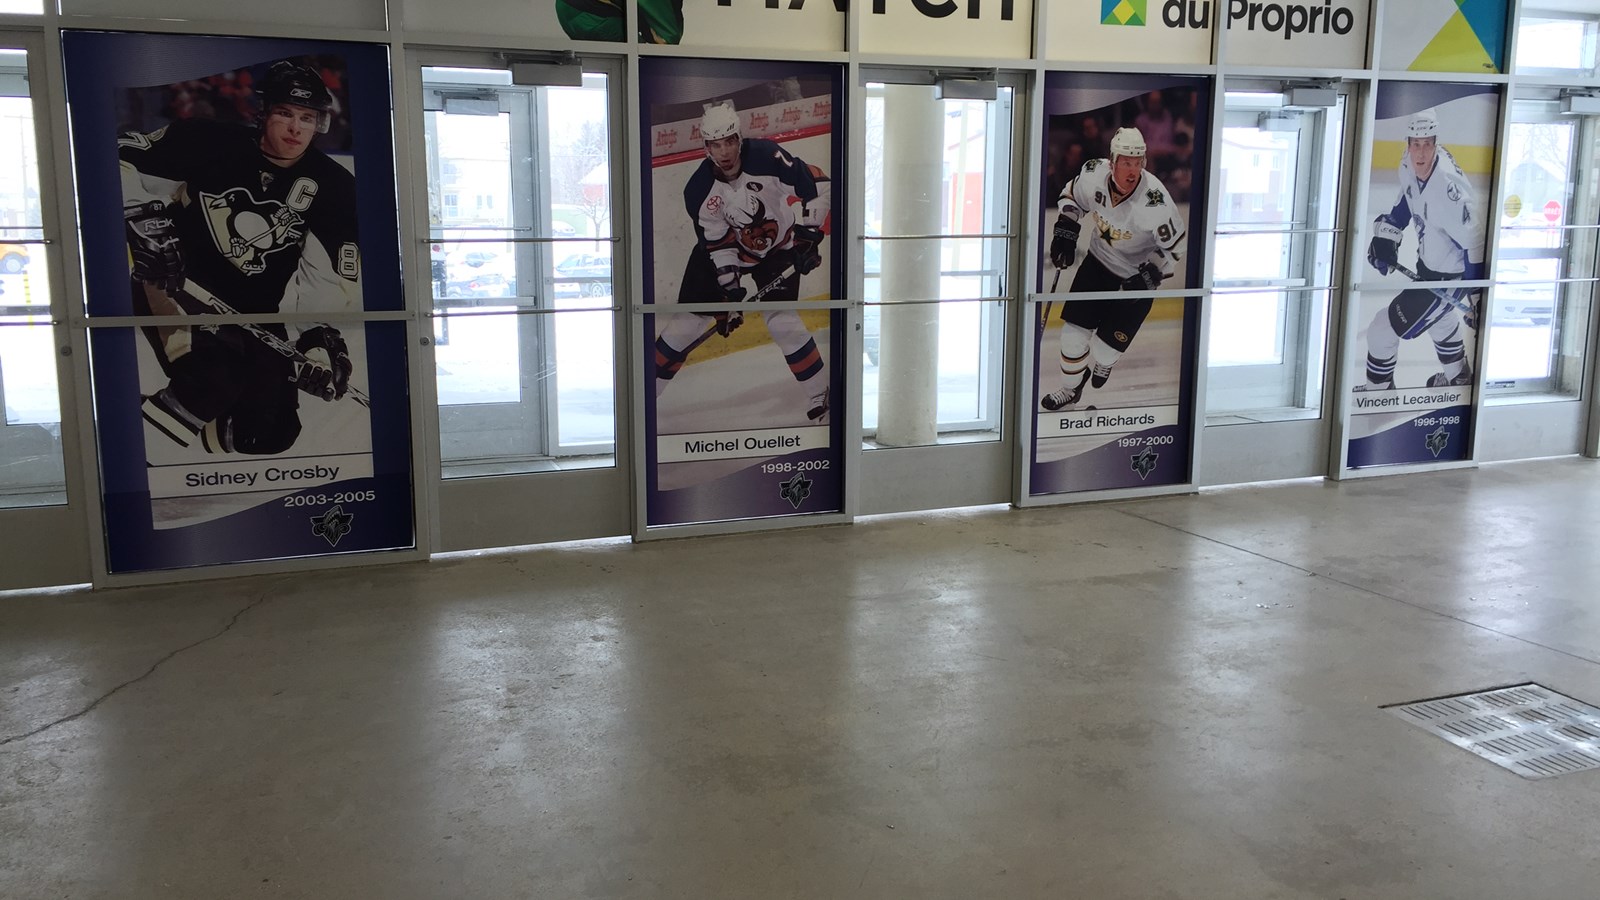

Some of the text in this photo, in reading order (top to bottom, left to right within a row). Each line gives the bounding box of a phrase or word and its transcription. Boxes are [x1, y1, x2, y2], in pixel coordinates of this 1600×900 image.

[1226, 0, 1354, 40] Proprio
[285, 177, 319, 212] C
[1094, 190, 1107, 208] 91
[1156, 217, 1178, 243] 91
[1356, 392, 1461, 408] Vincent Lecavalier
[1059, 413, 1155, 430] Brad Richards
[1413, 416, 1460, 428] 1996-1998
[684, 435, 801, 454] Michel Ouellet
[1117, 435, 1174, 448] 1997-2000
[761, 460, 830, 474] 1998-2002
[185, 465, 341, 488] Sidney Crosby
[283, 490, 376, 508] 2003-2005
